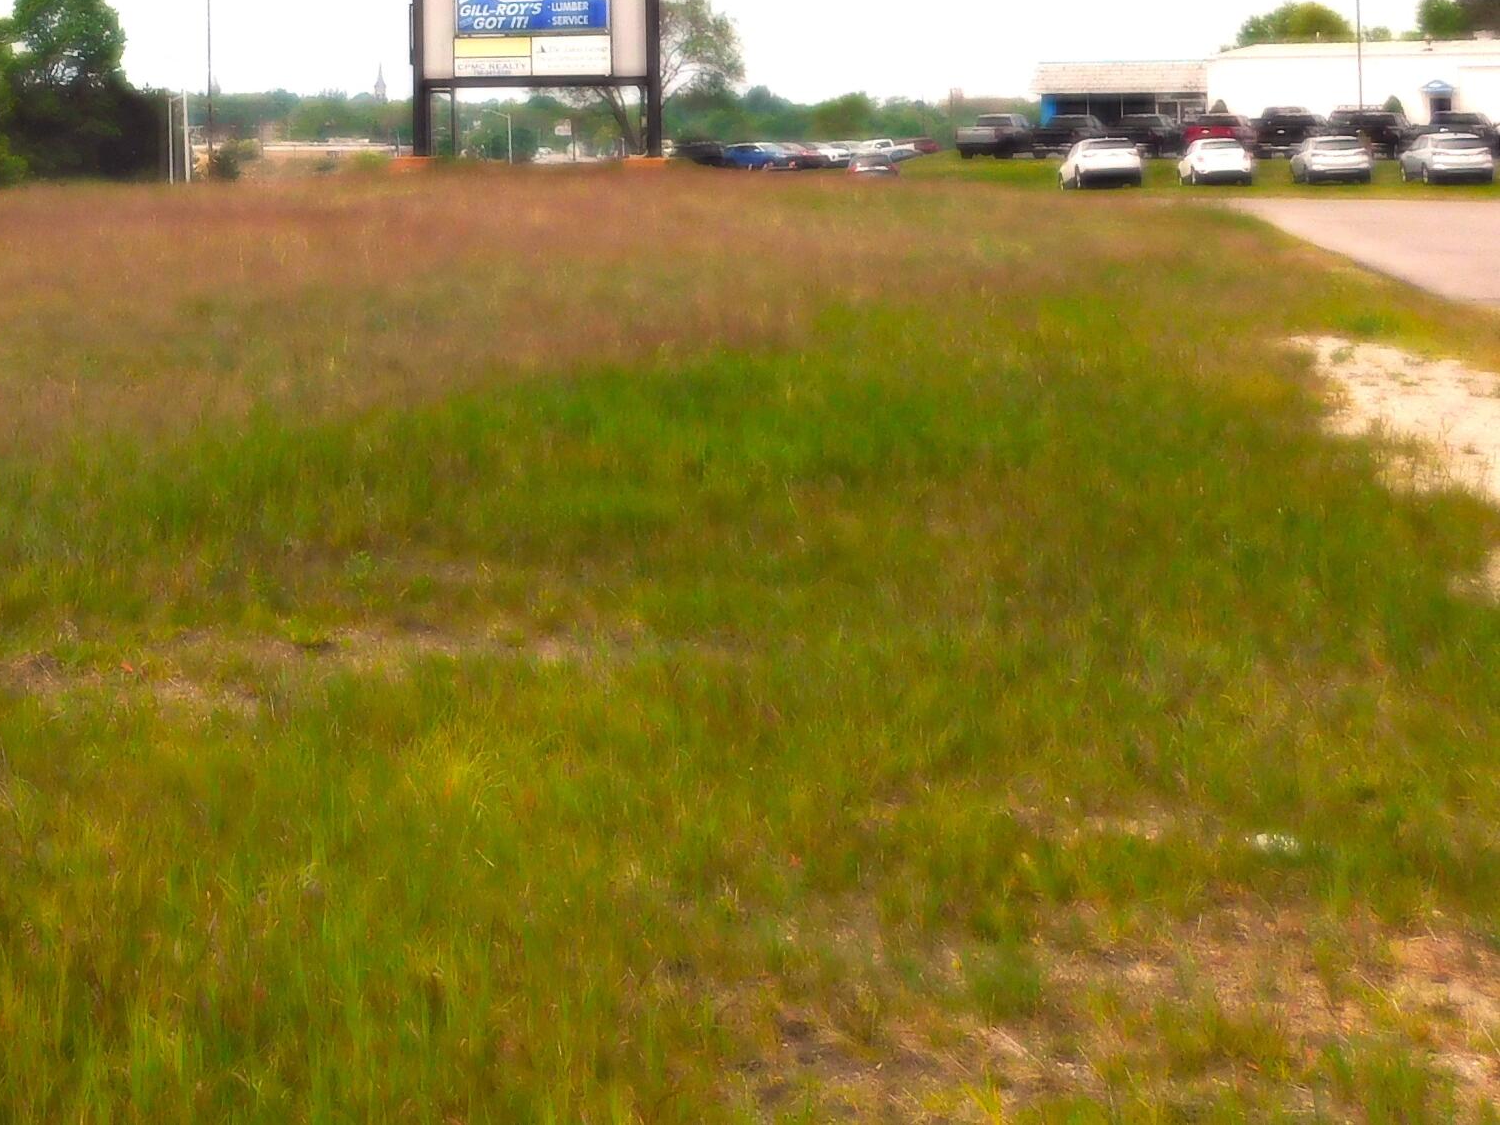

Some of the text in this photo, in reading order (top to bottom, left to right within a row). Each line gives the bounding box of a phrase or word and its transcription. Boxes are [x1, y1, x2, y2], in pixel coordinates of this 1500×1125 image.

[459, 2, 542, 17] GILL-ROY'S
[551, 1, 589, 12] LUMBER
[473, 16, 505, 30] GOT
[510, 16, 529, 29] IT!
[551, 15, 589, 26] SERVICE
